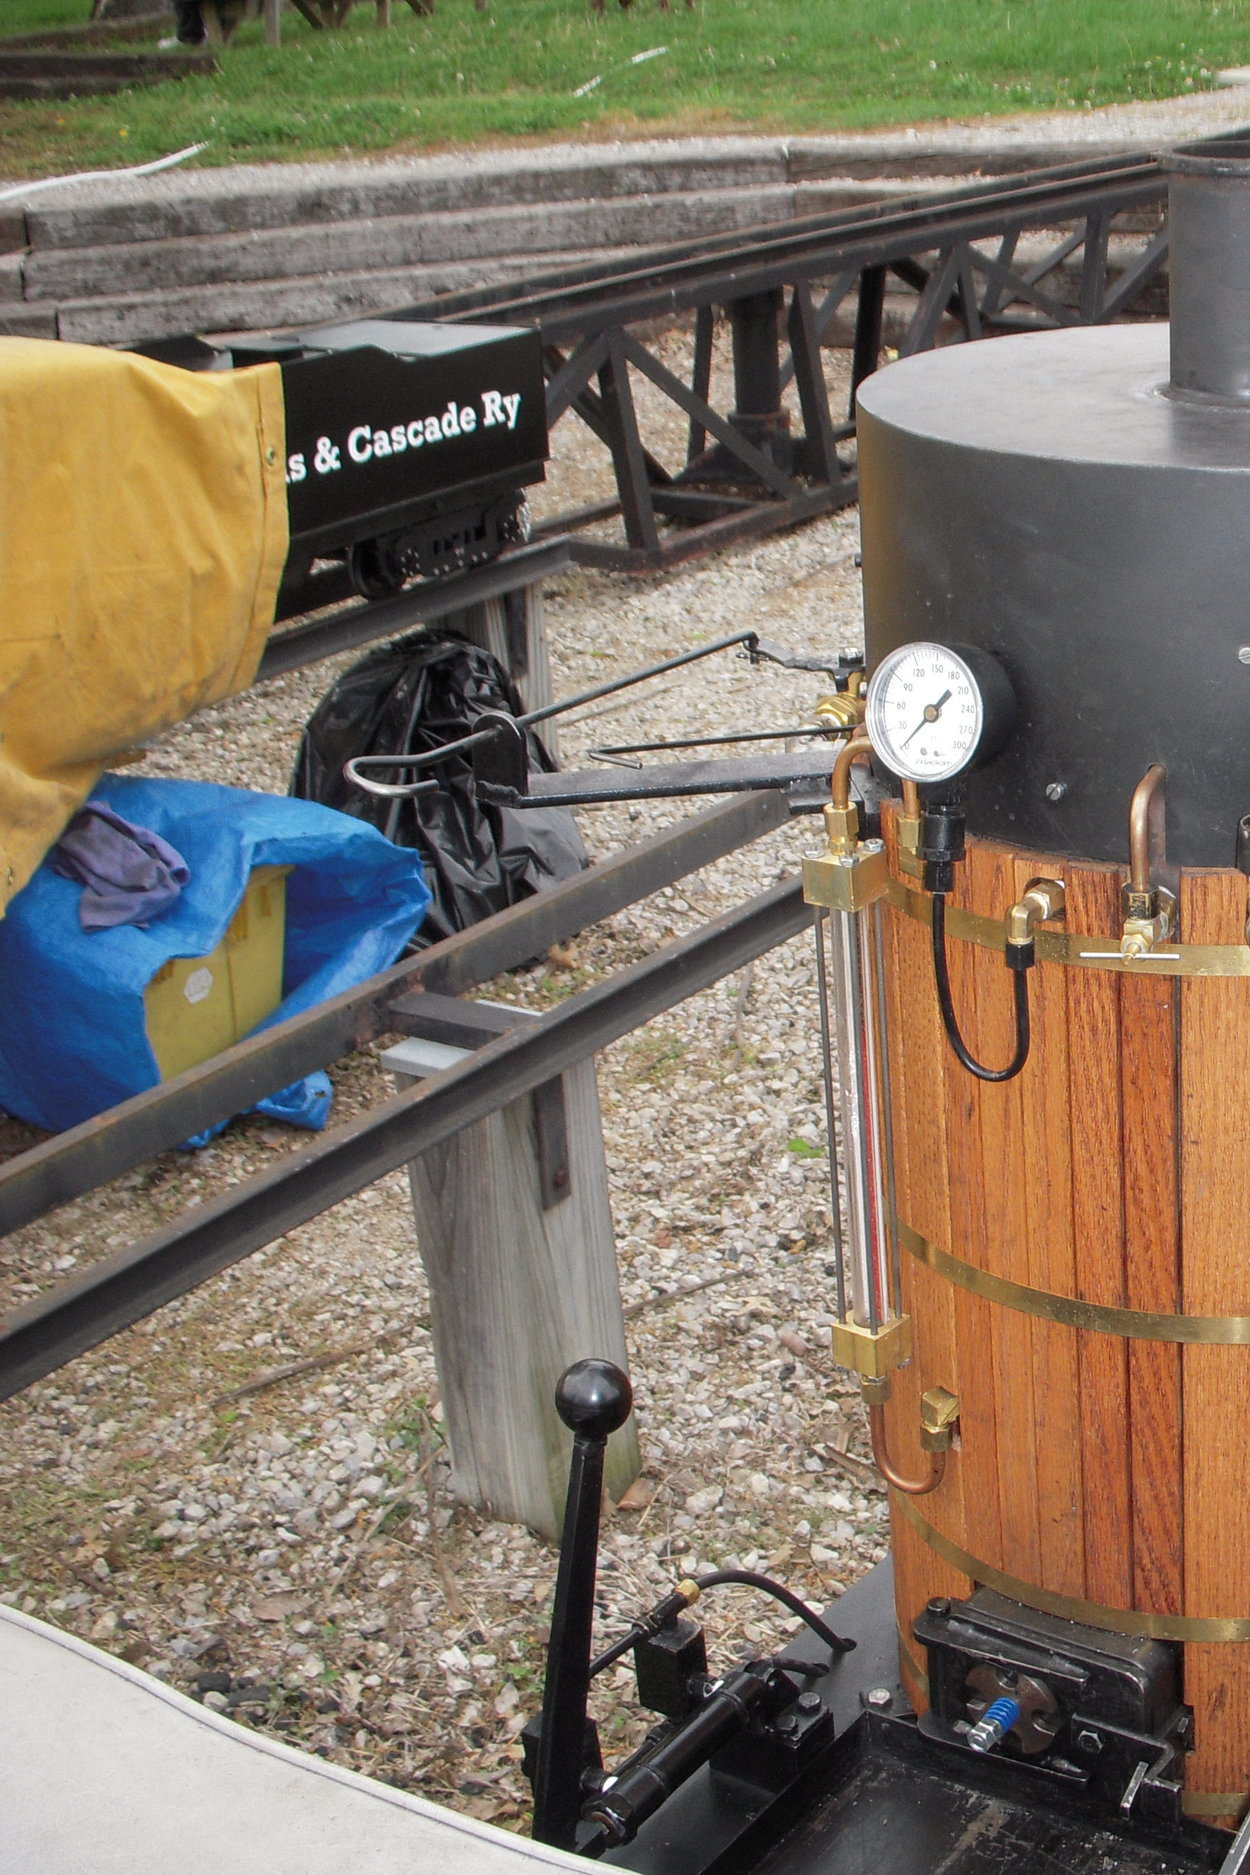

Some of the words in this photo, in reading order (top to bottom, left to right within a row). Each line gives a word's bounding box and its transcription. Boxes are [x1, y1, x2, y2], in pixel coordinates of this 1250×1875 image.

[285, 453, 307, 484] s
[313, 436, 341, 474] &
[347, 401, 476, 464] Cascade
[481, 390, 521, 430] Ry
[912, 667, 925, 678] 120
[931, 664, 944, 673] 150
[947, 671, 961, 680] 180
[903, 683, 913, 692] 90
[957, 686, 970, 695] 210
[896, 701, 907, 710] 60
[961, 705, 975, 714] 240
[898, 721, 908, 730] 30
[959, 725, 972, 735] 270
[952, 740, 967, 750] 300
